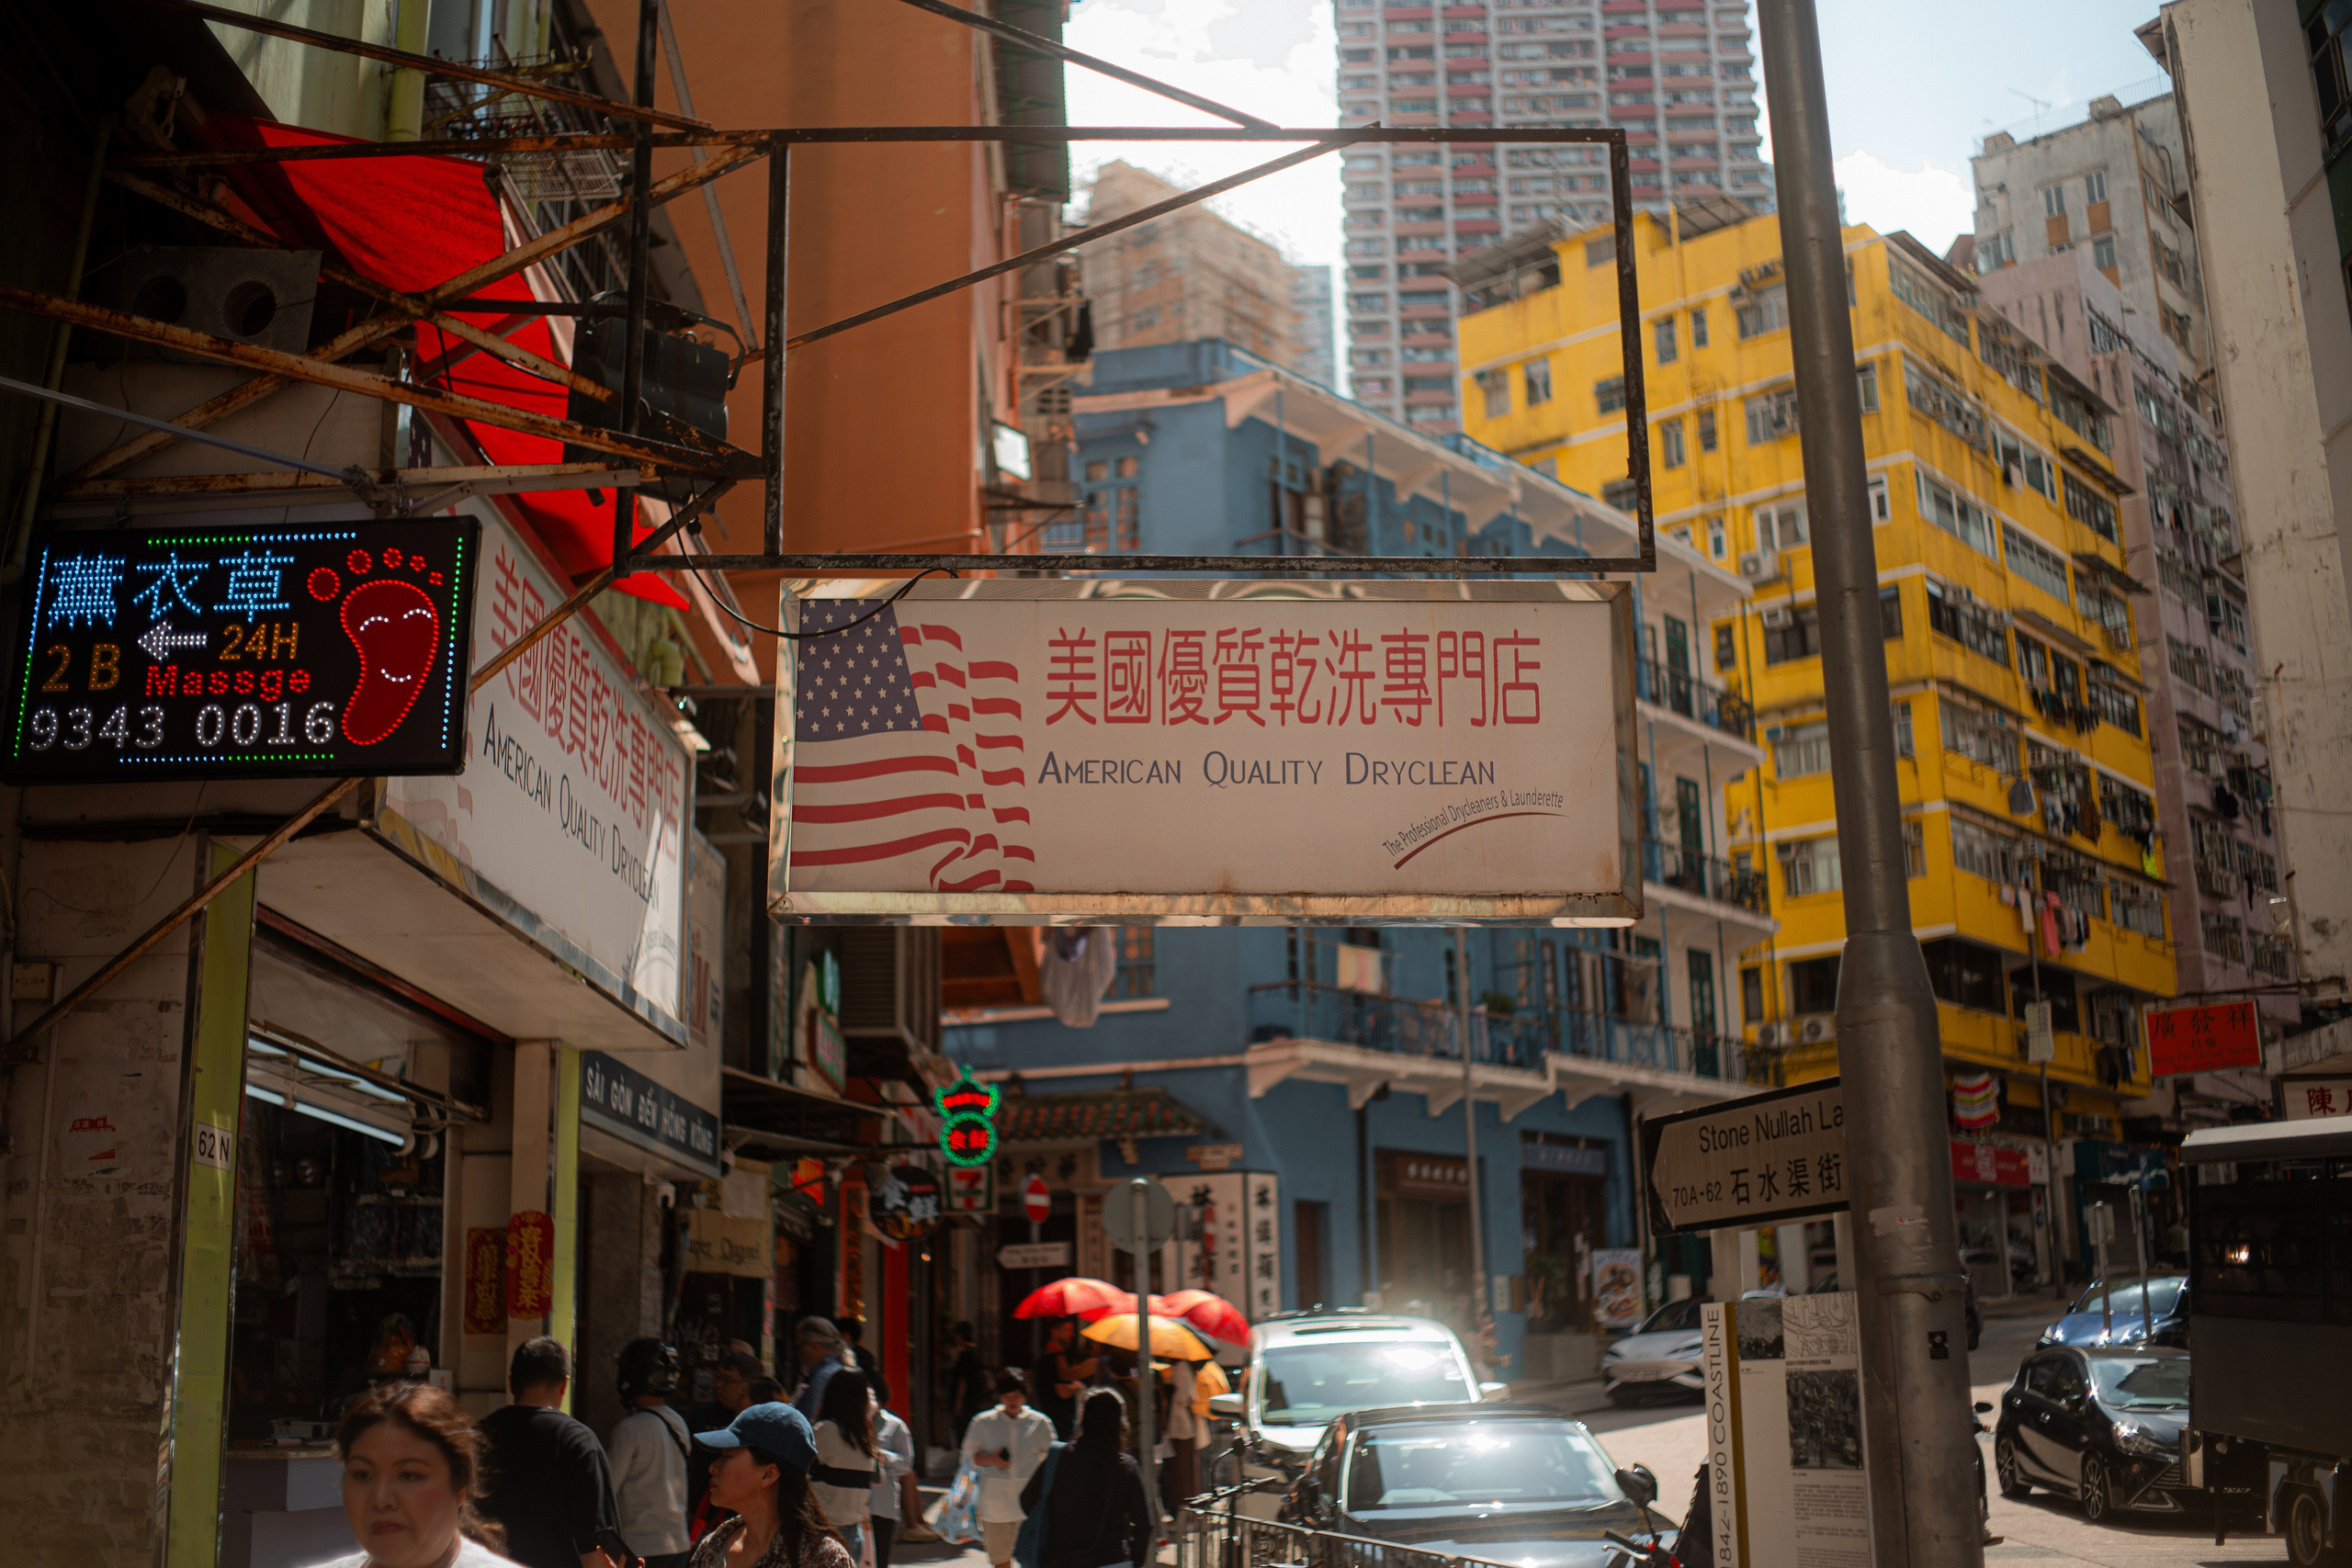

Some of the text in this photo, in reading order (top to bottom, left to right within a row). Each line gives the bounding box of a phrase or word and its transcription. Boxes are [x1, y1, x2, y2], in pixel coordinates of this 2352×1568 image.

[219, 622, 300, 660] 24H
[145, 664, 311, 702] Massge
[1045, 626, 1542, 728] 美國優質乾洗專門店
[28, 701, 336, 751] 9343 0016
[483, 701, 552, 815] AMERICAN
[560, 773, 606, 863] QUALITY
[1037, 750, 1496, 789] AMERICAN QUALITY DRYCLEAN
[1382, 787, 1564, 857] The Professional Drycleaners & Launderette
[1700, 1100, 1843, 1153] Stone Nullah La
[1730, 1153, 1841, 1205] 石水渠街
[1707, 1309, 1726, 1445] COASTLINE
